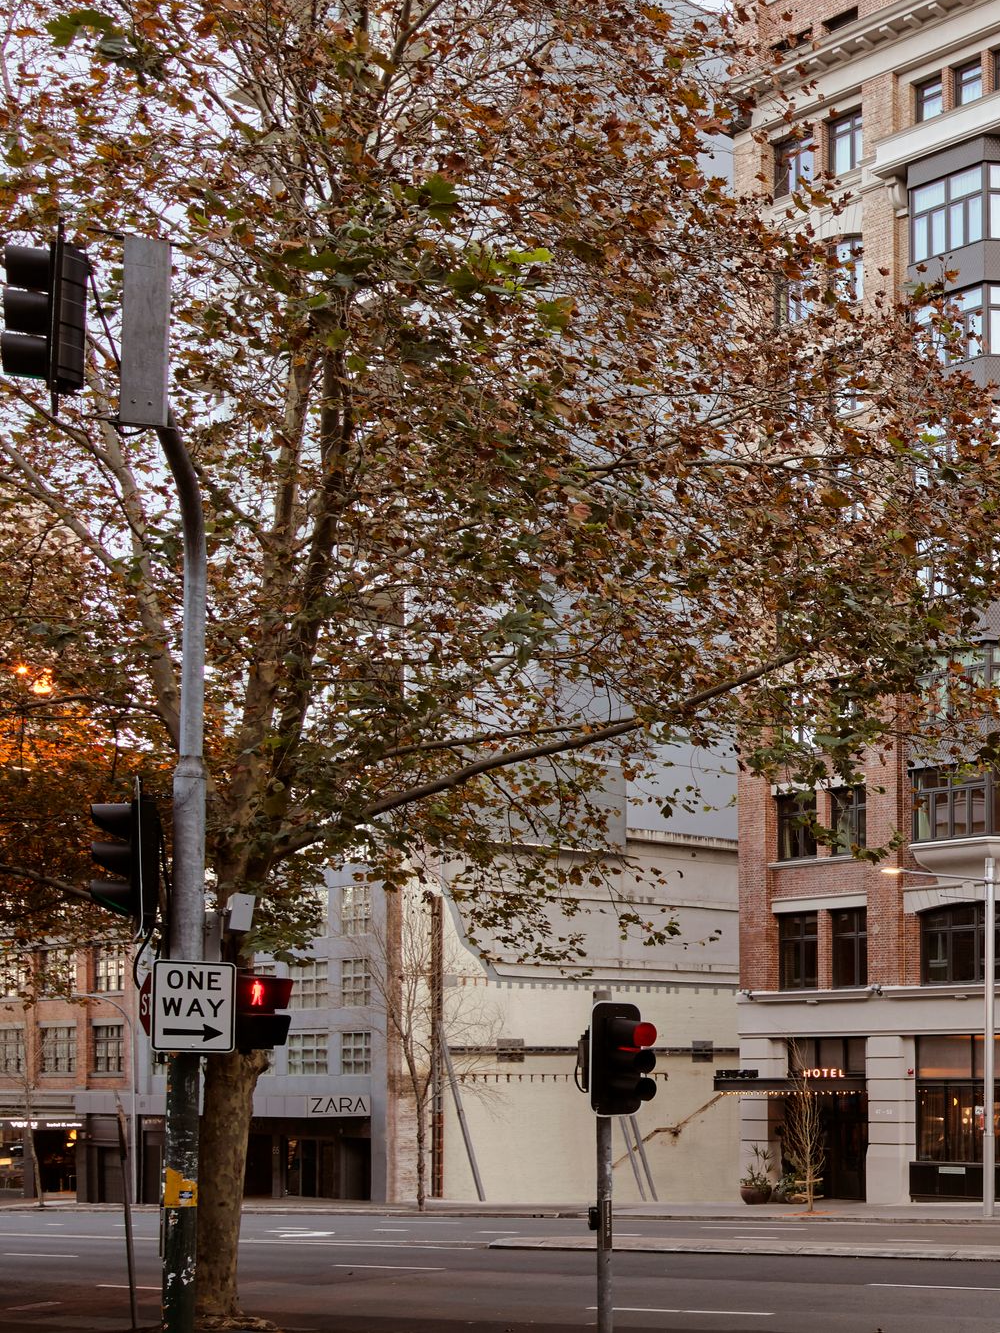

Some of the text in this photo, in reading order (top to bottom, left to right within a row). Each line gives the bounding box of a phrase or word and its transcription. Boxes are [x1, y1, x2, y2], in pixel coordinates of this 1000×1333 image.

[167, 969, 222, 991] ONE
[162, 997, 225, 1018] WAY
[803, 1068, 846, 1078] HOTEL
[311, 1097, 367, 1114] ZARA
